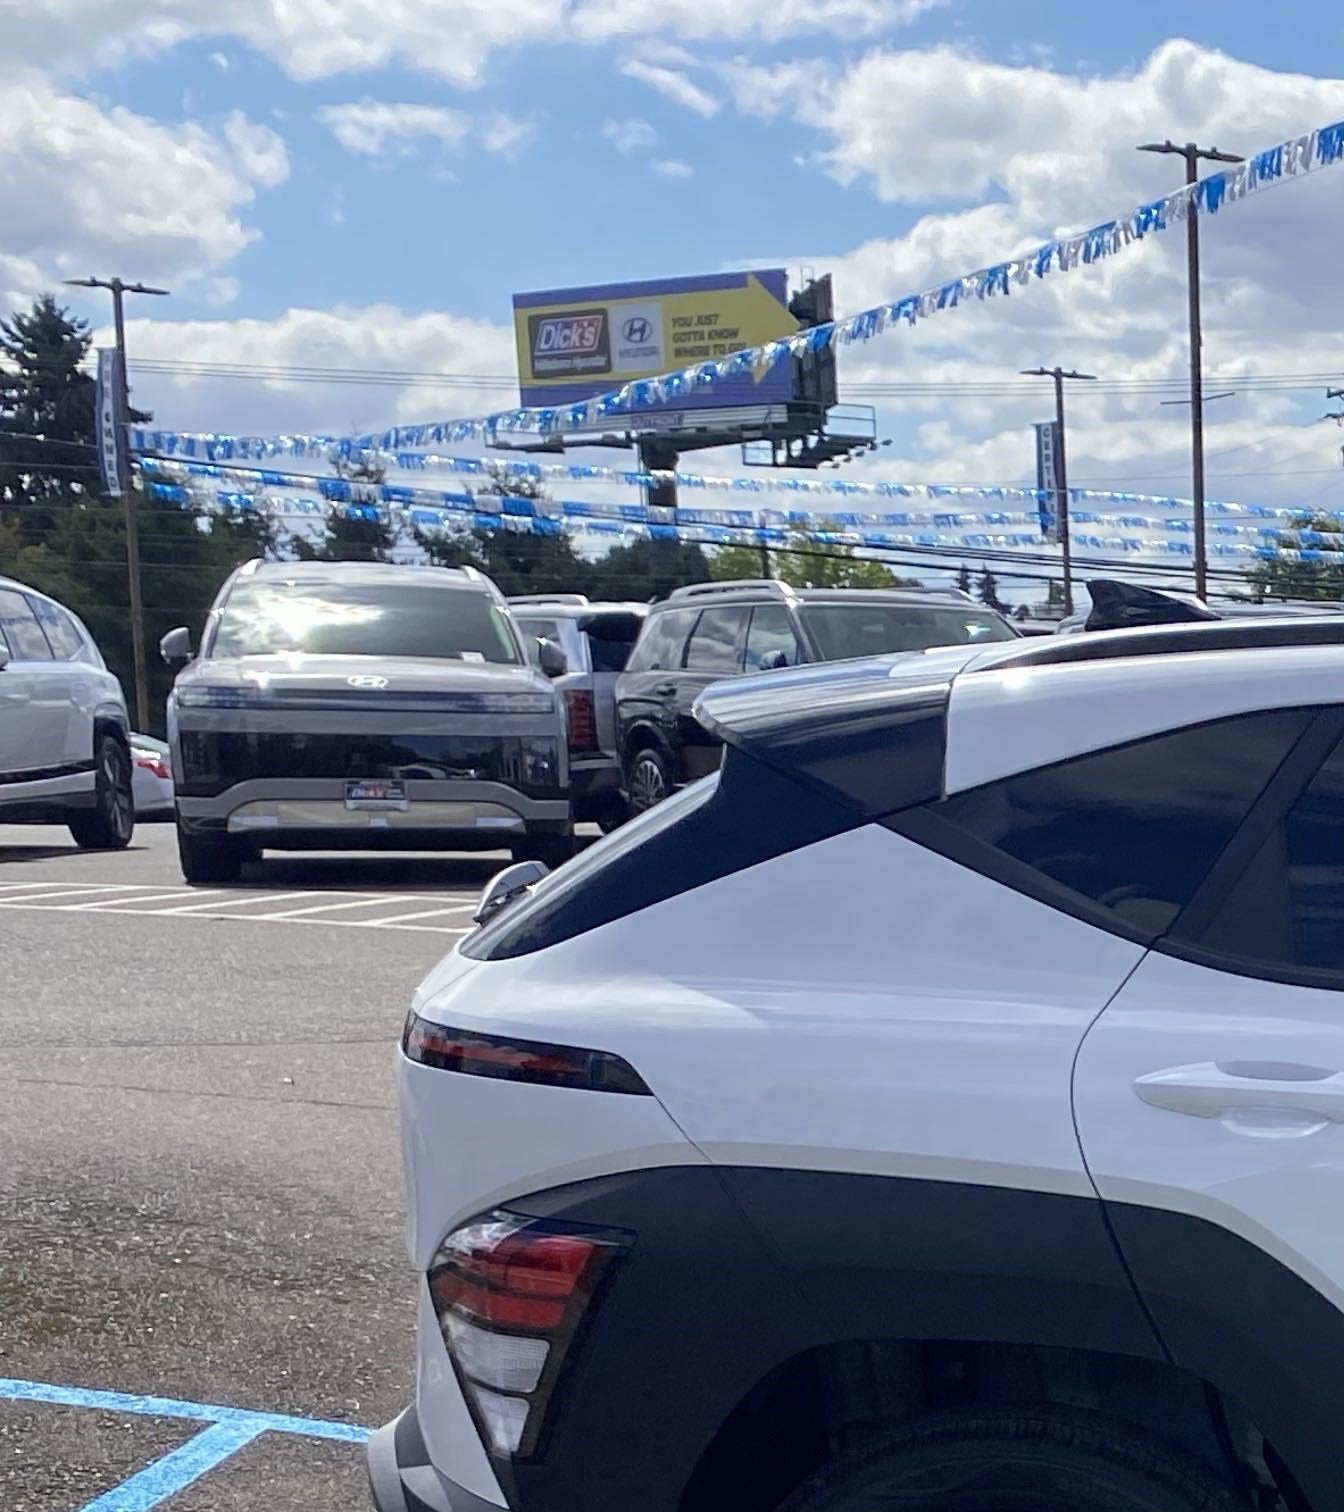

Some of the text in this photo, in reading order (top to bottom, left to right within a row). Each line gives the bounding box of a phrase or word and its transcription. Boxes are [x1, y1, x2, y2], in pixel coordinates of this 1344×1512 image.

[672, 313, 720, 328] YOU JUST
[540, 321, 597, 350] Dick's
